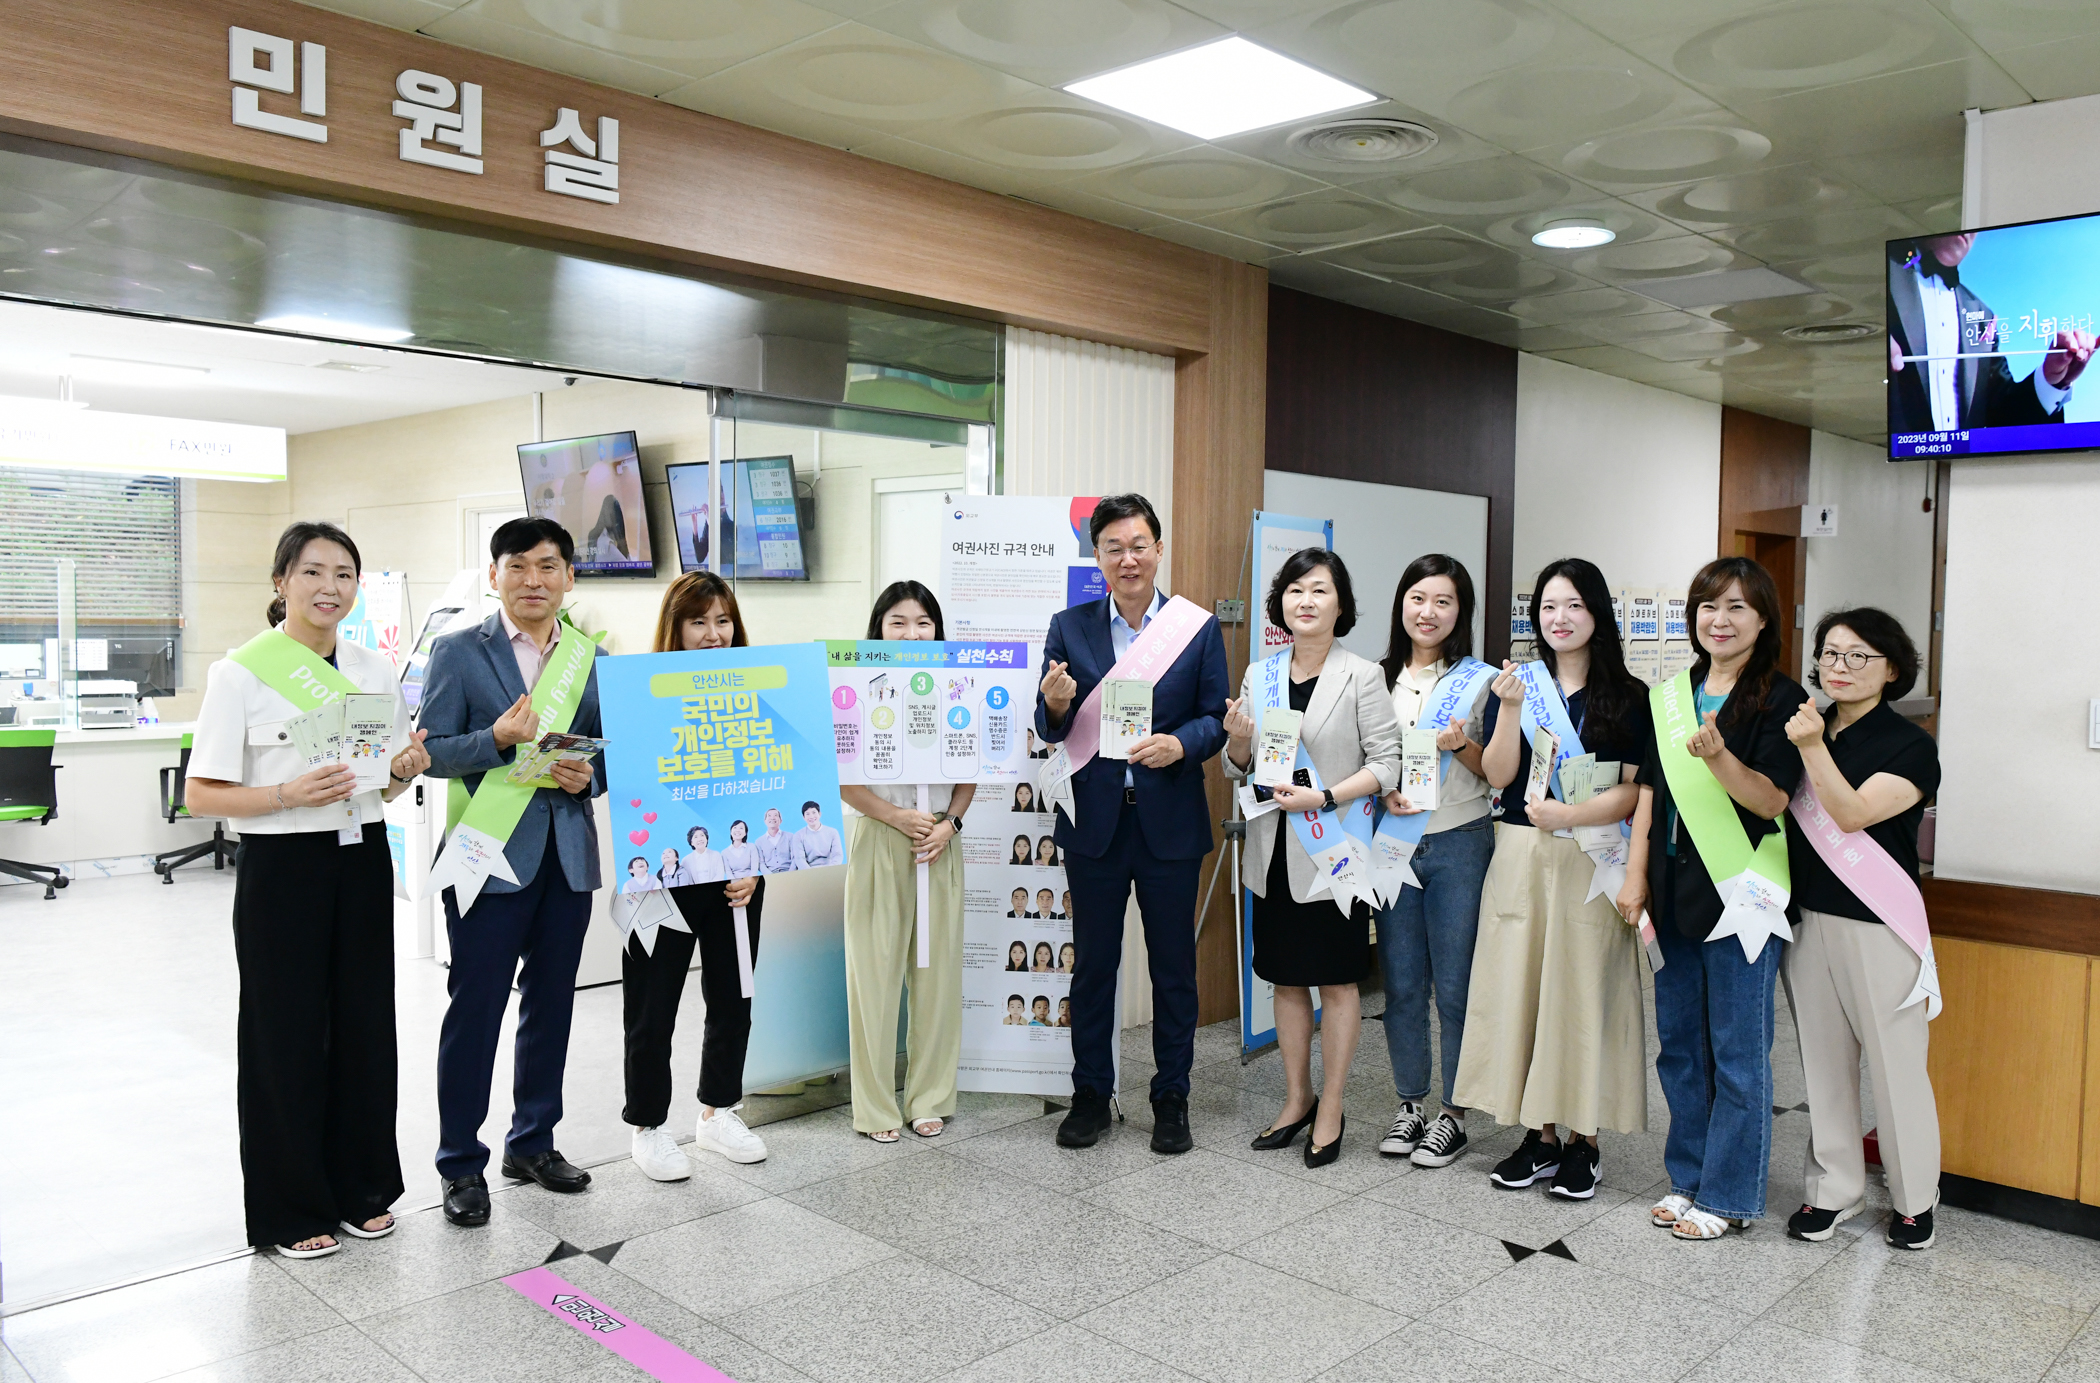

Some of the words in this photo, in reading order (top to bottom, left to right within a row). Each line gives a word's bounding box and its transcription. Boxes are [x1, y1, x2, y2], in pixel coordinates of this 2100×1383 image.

[1965, 322, 2013, 346] 안산을
[2018, 308, 2095, 348] 지휘하다
[1897, 432, 1927, 444] 2023년
[1929, 431, 1948, 443] 09월
[1950, 430, 1970, 442] 11일
[1915, 443, 1952, 454] 09:40:10
[952, 542, 1000, 556] 여권사진
[1003, 542, 1027, 556] 규격
[1030, 543, 1055, 557] 안내
[843, 651, 862, 662] 삶을
[864, 651, 891, 662] 지키는
[894, 652, 929, 662] 개인정보
[956, 648, 1014, 664] 실천수칙
[550, 639, 587, 705] Privacy
[692, 673, 745, 690] 안산시는
[917, 676, 927, 691] 3
[840, 689, 847, 705] 1
[993, 690, 1003, 706] 5
[682, 692, 760, 723] 국민의
[878, 710, 888, 726] 2
[953, 710, 963, 726] 4
[671, 718, 775, 753] 개인정보
[1669, 725, 1687, 748] it.
[657, 749, 736, 784] 보호를
[742, 744, 793, 774] 위해
[671, 784, 710, 802] 최선을
[712, 776, 787, 798] 다하겠습니다
